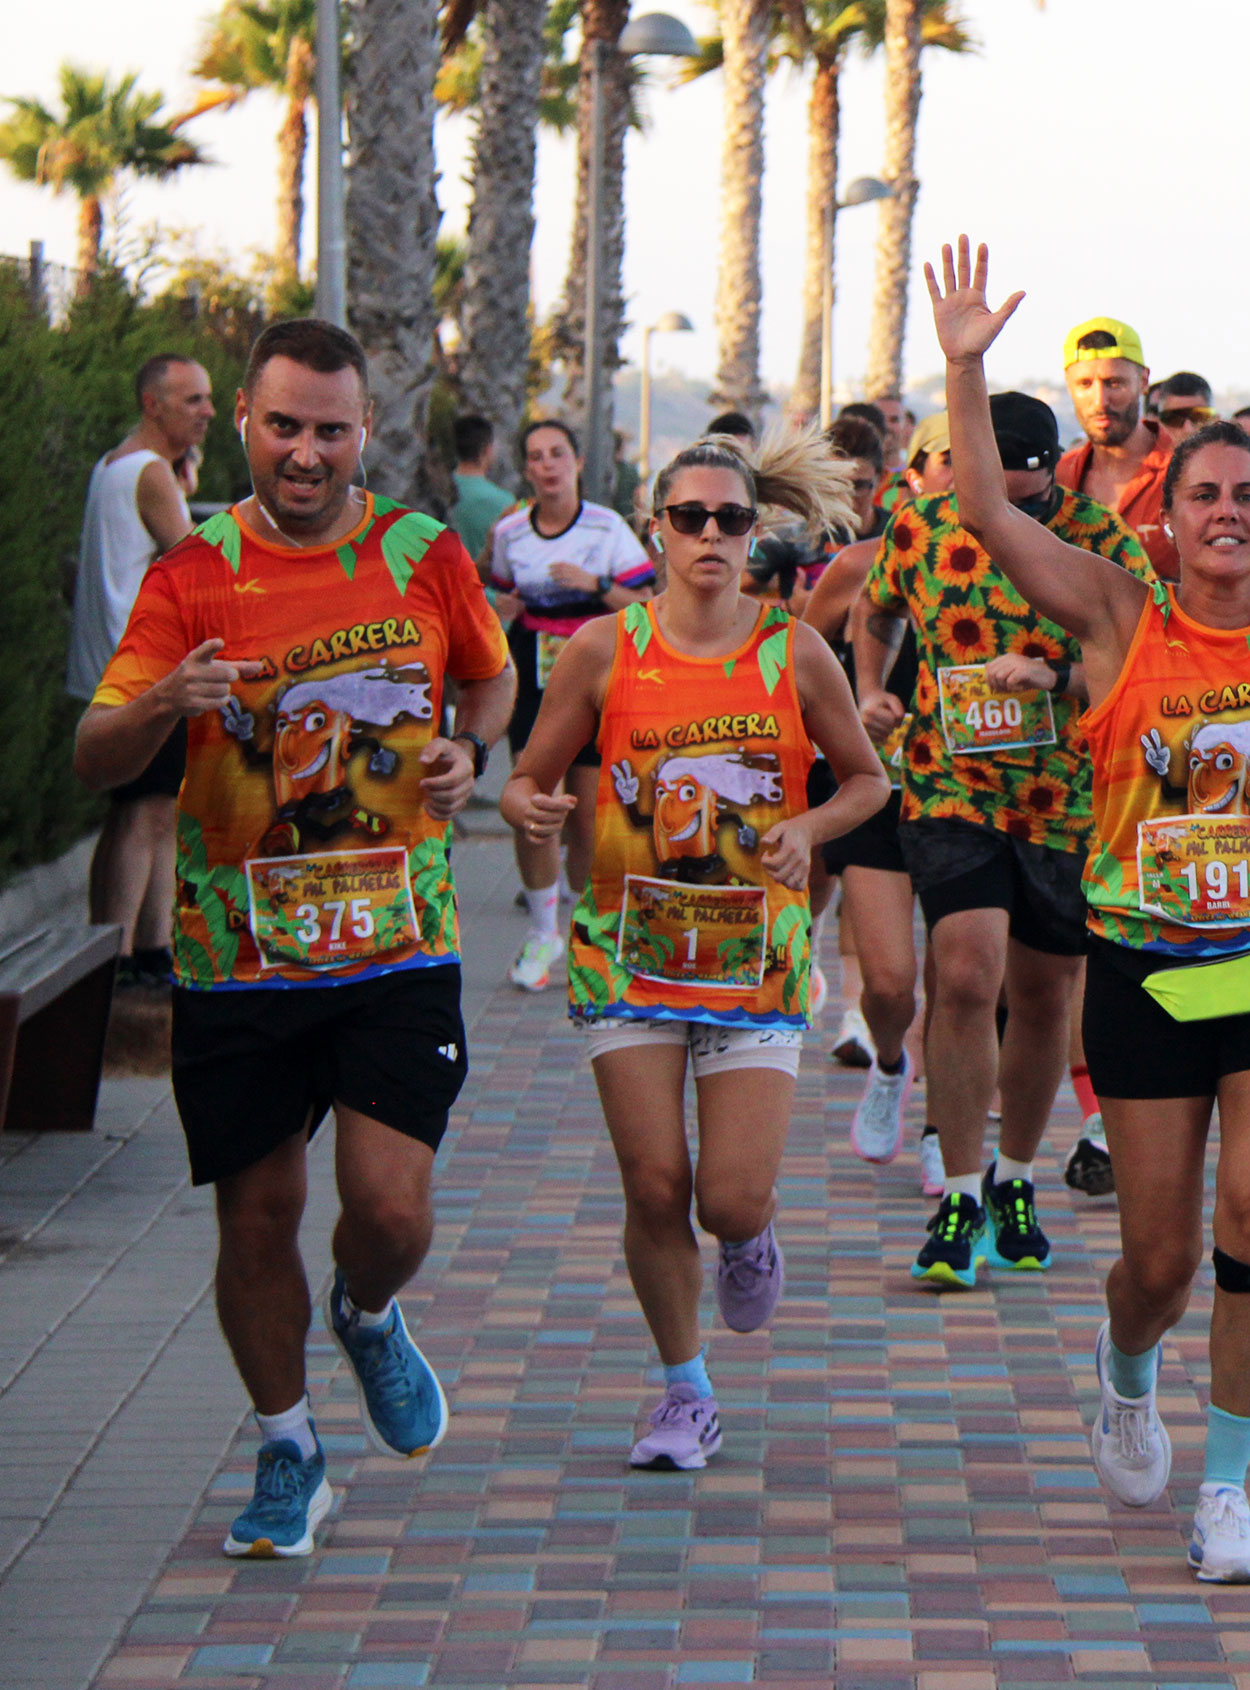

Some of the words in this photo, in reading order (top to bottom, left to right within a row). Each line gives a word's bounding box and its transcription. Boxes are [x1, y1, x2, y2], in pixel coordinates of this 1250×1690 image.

[285, 617, 422, 676] CARRERA
[965, 698, 1022, 730] 460
[1161, 695, 1193, 718] LA
[631, 729, 660, 749] LA
[665, 713, 781, 748] CARRERA
[1180, 859, 1249, 900] 191
[296, 898, 375, 944] 375
[683, 926, 699, 961] 1
